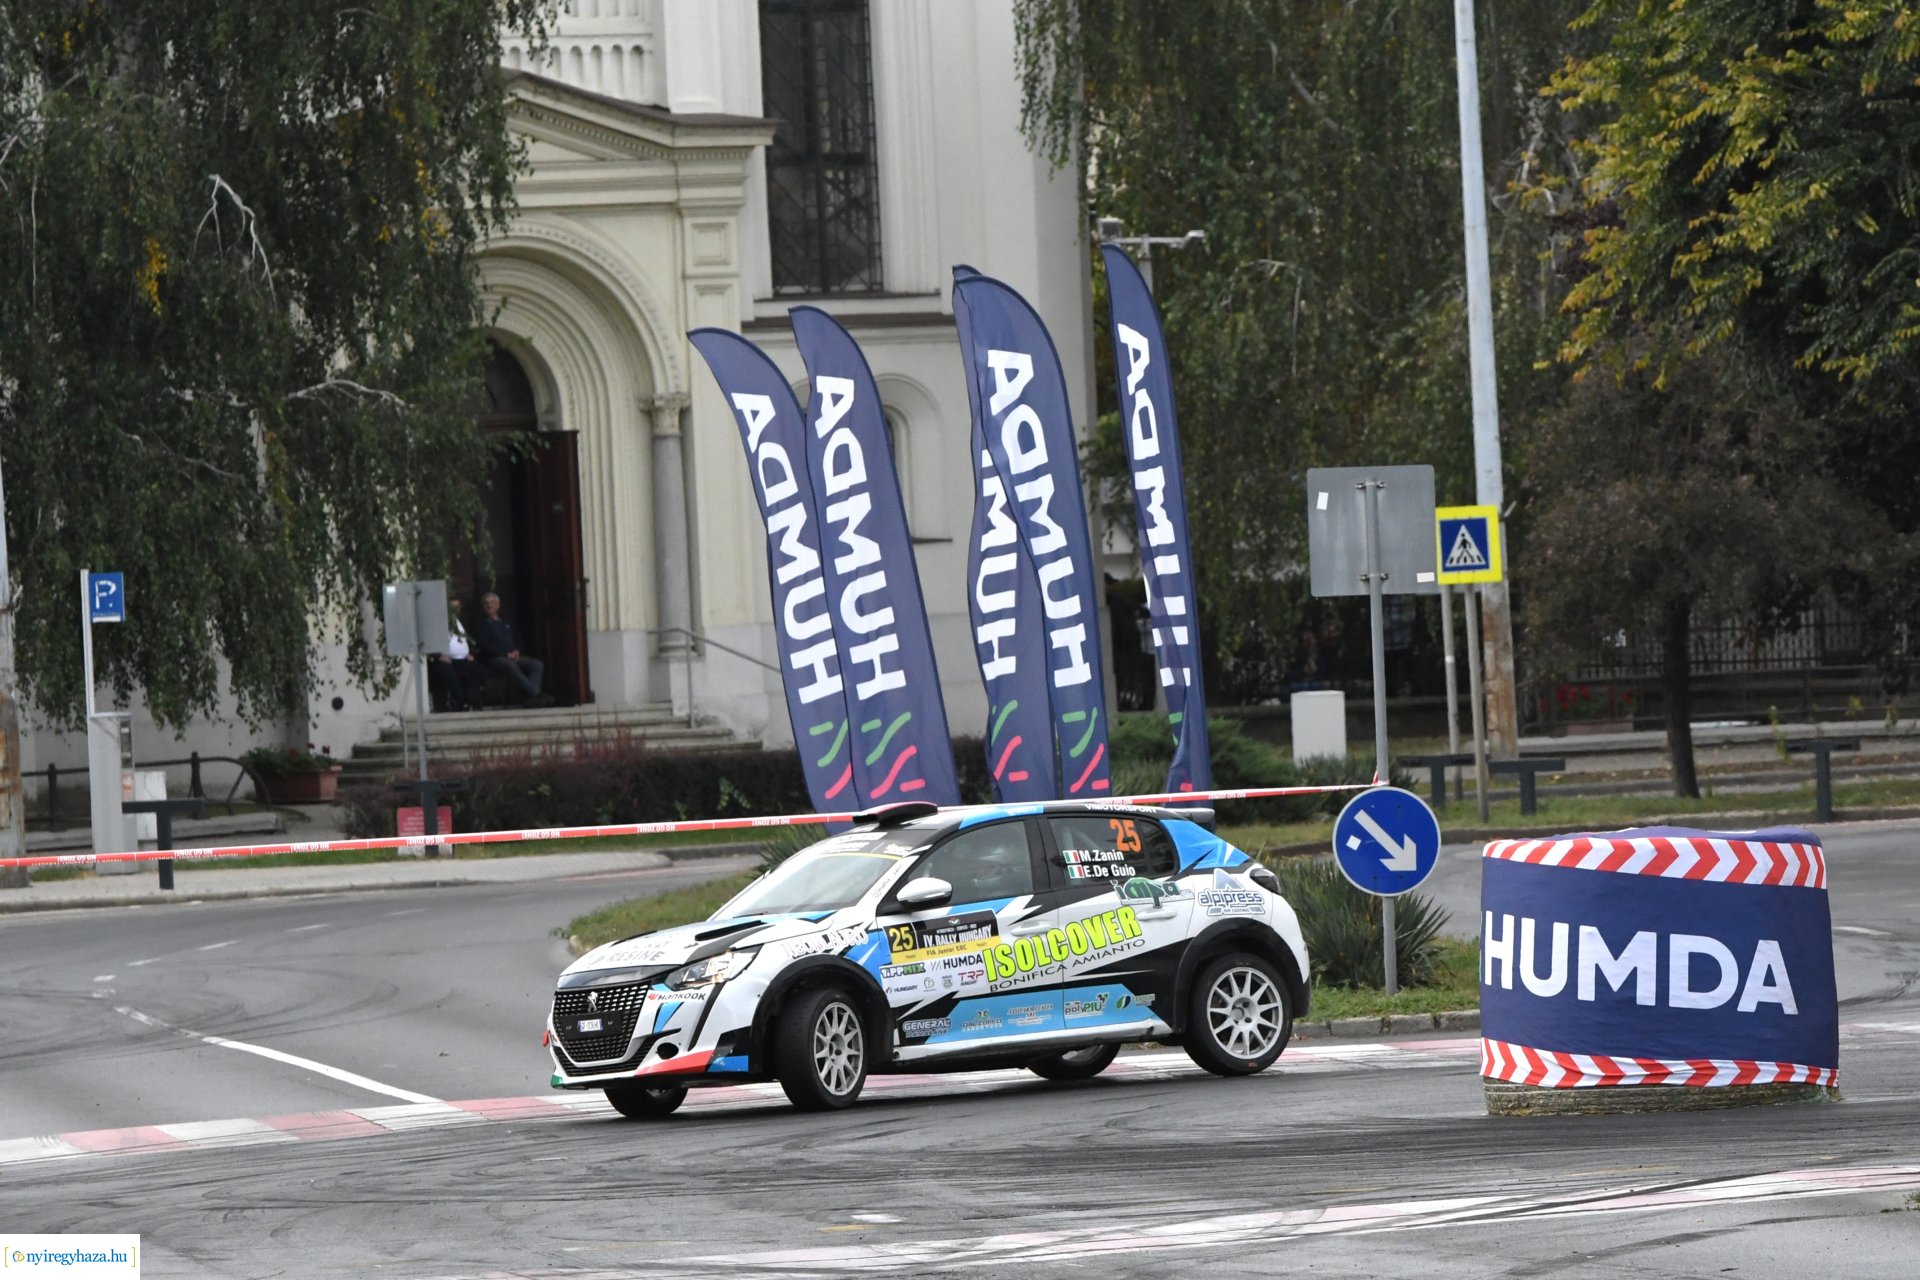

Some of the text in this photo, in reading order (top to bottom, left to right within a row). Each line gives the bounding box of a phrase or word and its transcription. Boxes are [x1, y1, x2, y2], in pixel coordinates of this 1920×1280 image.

[1109, 818, 1141, 852] 25
[1079, 849, 1125, 862] M.Zanin
[1110, 864, 1136, 877] Guio
[1200, 890, 1263, 907] alpipress
[888, 926, 914, 952] 25
[923, 934, 935, 948] IV.
[935, 933, 958, 946] RALLY
[958, 923, 992, 943] HUNGARY
[982, 905, 1142, 982] ISOLCOVER
[938, 946, 955, 955] Junior
[943, 954, 983, 970] HUMDA
[990, 939, 1146, 992] BONIFICA AMIANTO
[1484, 910, 1799, 1016] HUMDA
[958, 970, 984, 981] TRP
[904, 1019, 950, 1031] GENERAL
